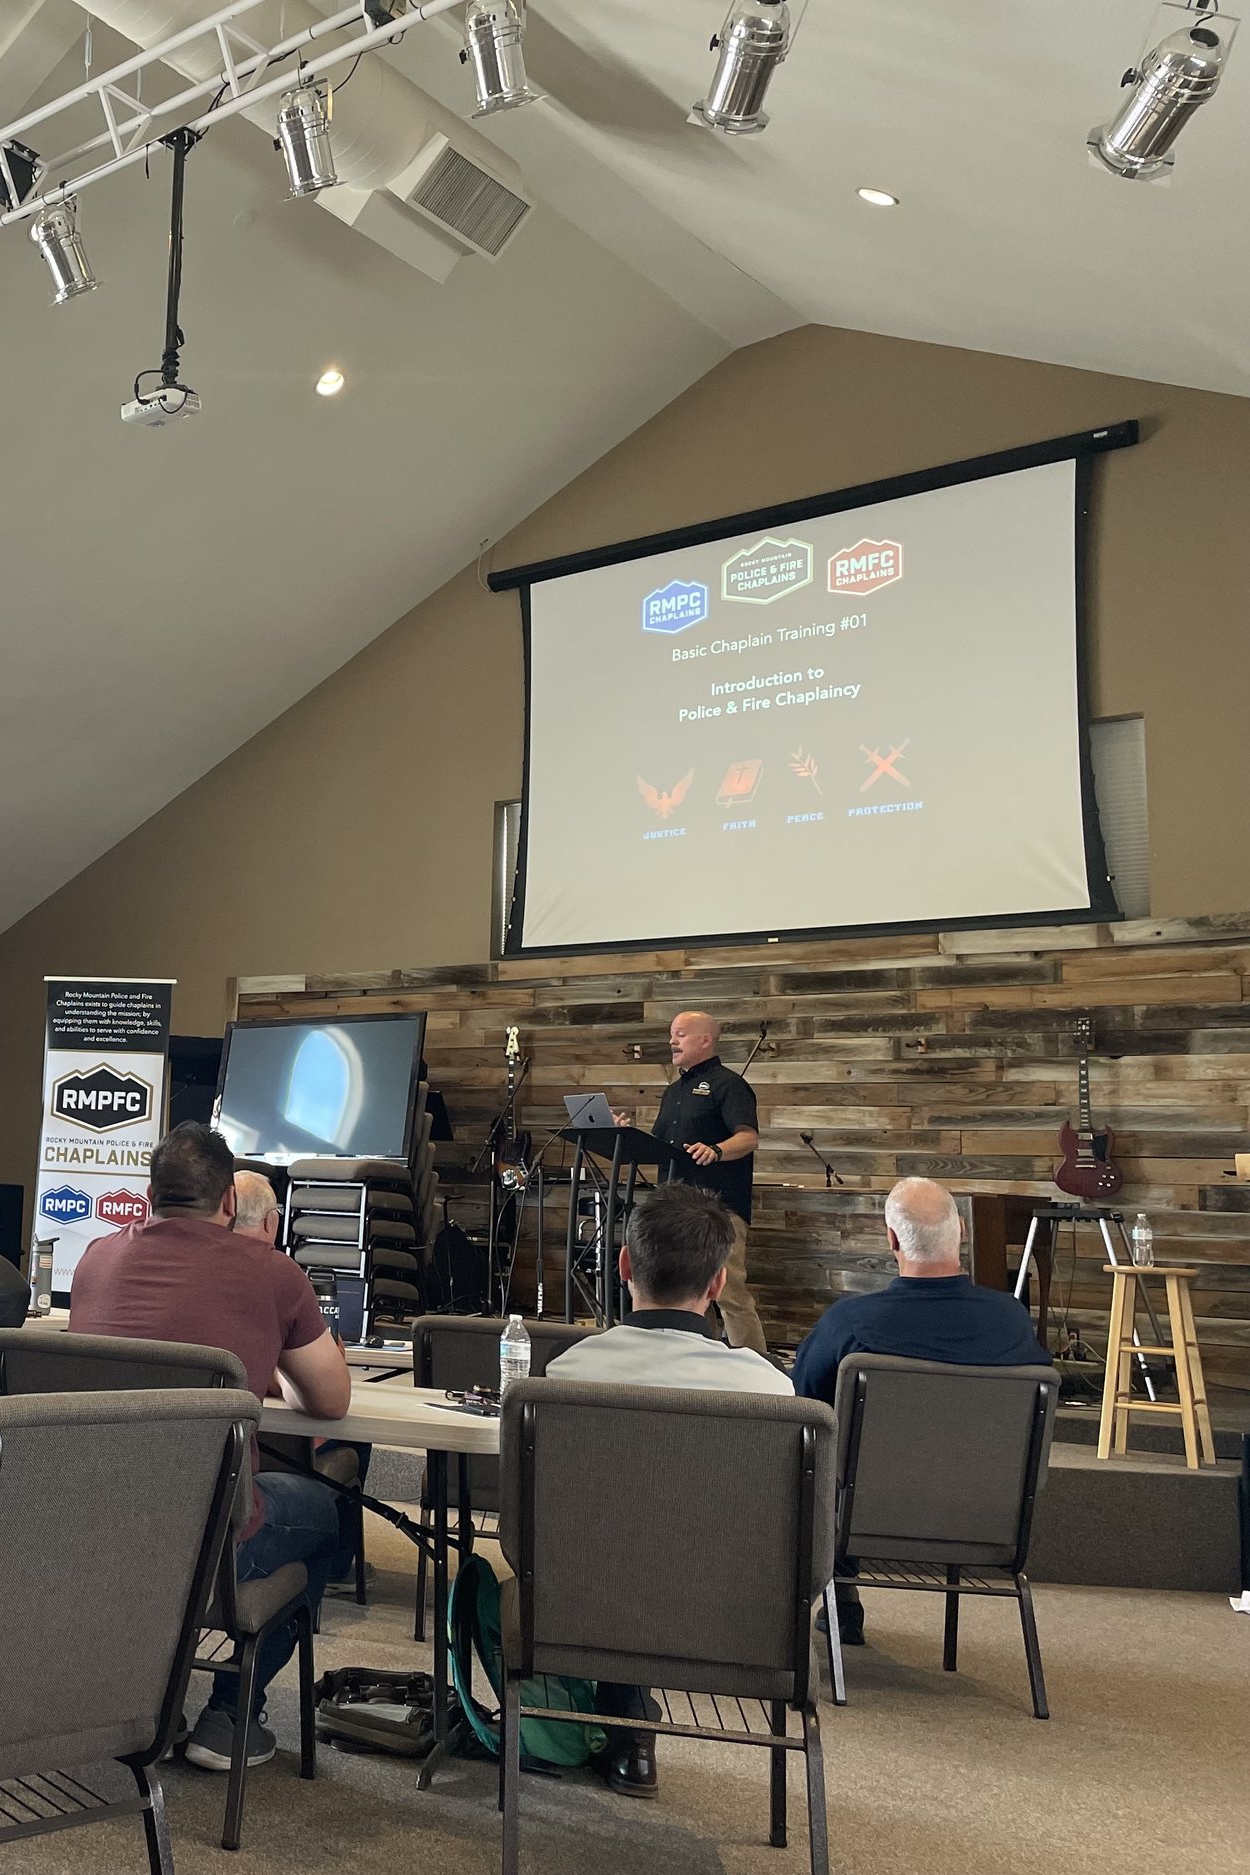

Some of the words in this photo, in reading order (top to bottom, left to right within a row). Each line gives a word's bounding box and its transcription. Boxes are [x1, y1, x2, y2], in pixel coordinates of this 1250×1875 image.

[730, 567, 767, 583] POLICE
[770, 565, 778, 574] &
[780, 559, 803, 572] FIRE
[836, 550, 894, 577] RMFC
[737, 571, 796, 591] CHAPLAINS
[836, 567, 894, 586] CHAPLAINS
[650, 592, 701, 616] RMPC
[649, 607, 701, 625] CHAPLAINS
[672, 645, 707, 662] Basic
[710, 633, 773, 654] Chaplain
[777, 622, 836, 642] Training
[840, 613, 867, 630] #01
[711, 671, 803, 696] Introduction
[807, 667, 825, 680] to
[679, 705, 722, 722] Police
[725, 701, 738, 715] &
[742, 697, 771, 712] Fire
[775, 683, 861, 706] Chaplaincy
[847, 801, 924, 817] PROTECTION
[722, 819, 757, 831] FAITH
[787, 812, 825, 824] PEACE
[643, 827, 687, 840] JUSTICE
[65, 991, 82, 999] Rocky
[65, 1009, 106, 1017] understanding
[109, 1001, 126, 1009] guide
[53, 1017, 82, 1025] equipping
[111, 1019, 146, 1027] knowledge,
[62, 1089, 141, 1112] RMPFC
[69, 1138, 104, 1146] MOUNTAIN
[44, 1146, 152, 1167] CHAPLAINS
[45, 1199, 86, 1213] RMPC
[102, 1202, 143, 1217] RMFC
